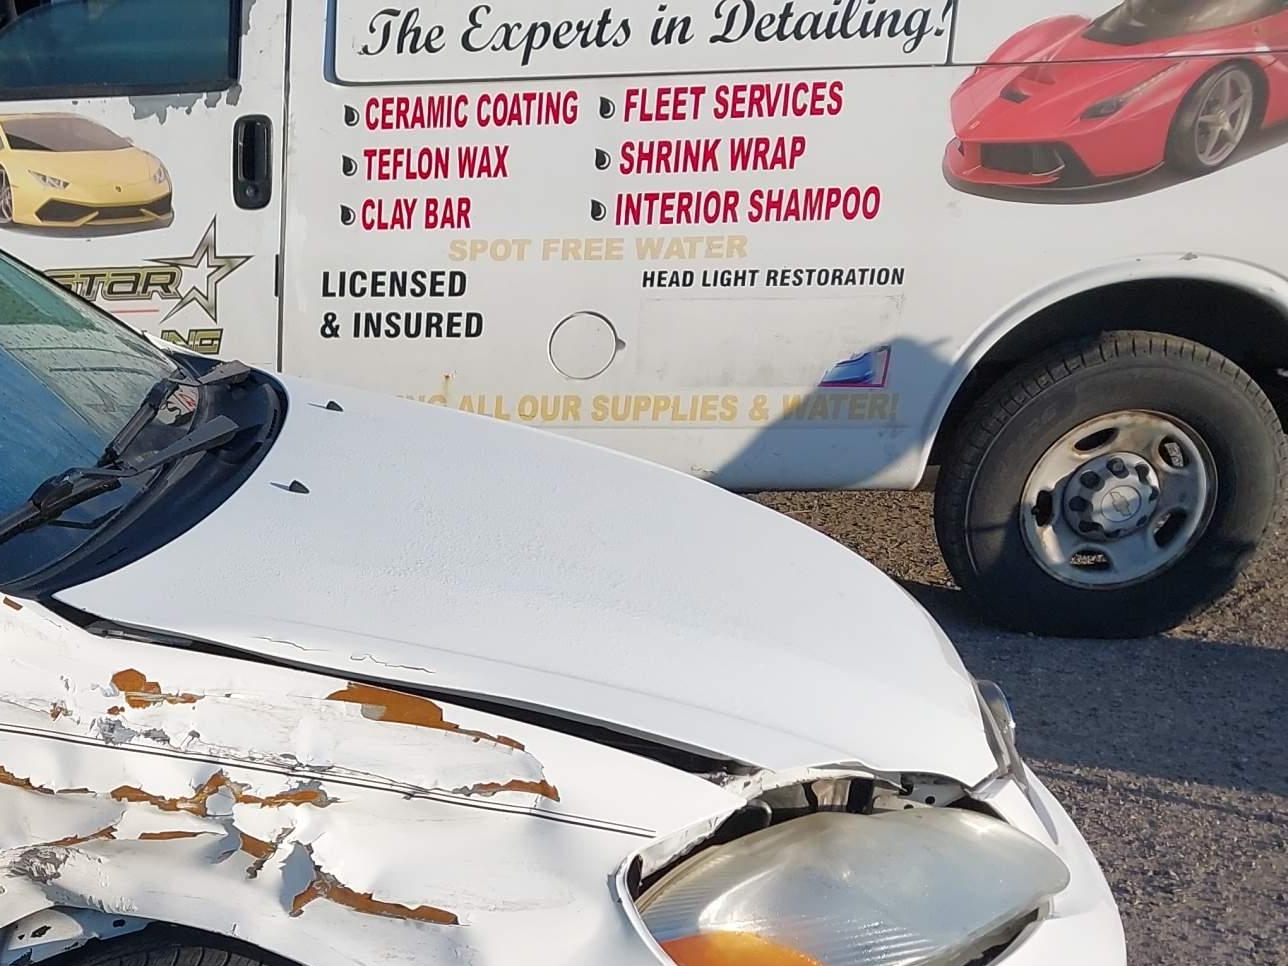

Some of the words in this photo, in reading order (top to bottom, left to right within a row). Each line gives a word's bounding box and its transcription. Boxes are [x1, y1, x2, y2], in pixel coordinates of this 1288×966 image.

[358, 7, 446, 56] The
[461, 4, 632, 66] Experts
[650, 4, 694, 46] in
[709, 0, 947, 53] Detailing!
[365, 95, 468, 130] CERAMIC
[477, 91, 578, 127] COATING
[624, 86, 706, 122] FLEET
[713, 81, 843, 120] SERVICES
[364, 148, 449, 181] TEFLON
[458, 146, 508, 177] WAX
[619, 139, 720, 175] SHRINK
[730, 136, 806, 171] WRAP
[361, 199, 416, 230] CLAY
[425, 197, 471, 229] BAR
[616, 190, 739, 224] INTERIOR
[748, 186, 880, 223] SHAMPOO
[448, 238, 531, 262] SPOT
[541, 238, 624, 260] FREE
[635, 235, 748, 260] WATER
[323, 271, 466, 297] LICENSED
[642, 270, 694, 288] HEAD
[702, 270, 758, 286] LIGHT
[766, 268, 904, 286] RESTORATION
[321, 313, 339, 338] &
[354, 312, 482, 338] INSURED
[458, 394, 512, 421] ALL
[516, 394, 583, 423] OUR
[592, 394, 737, 423] SUPPLIES
[749, 394, 770, 421] &
[782, 393, 900, 421] WATER!
